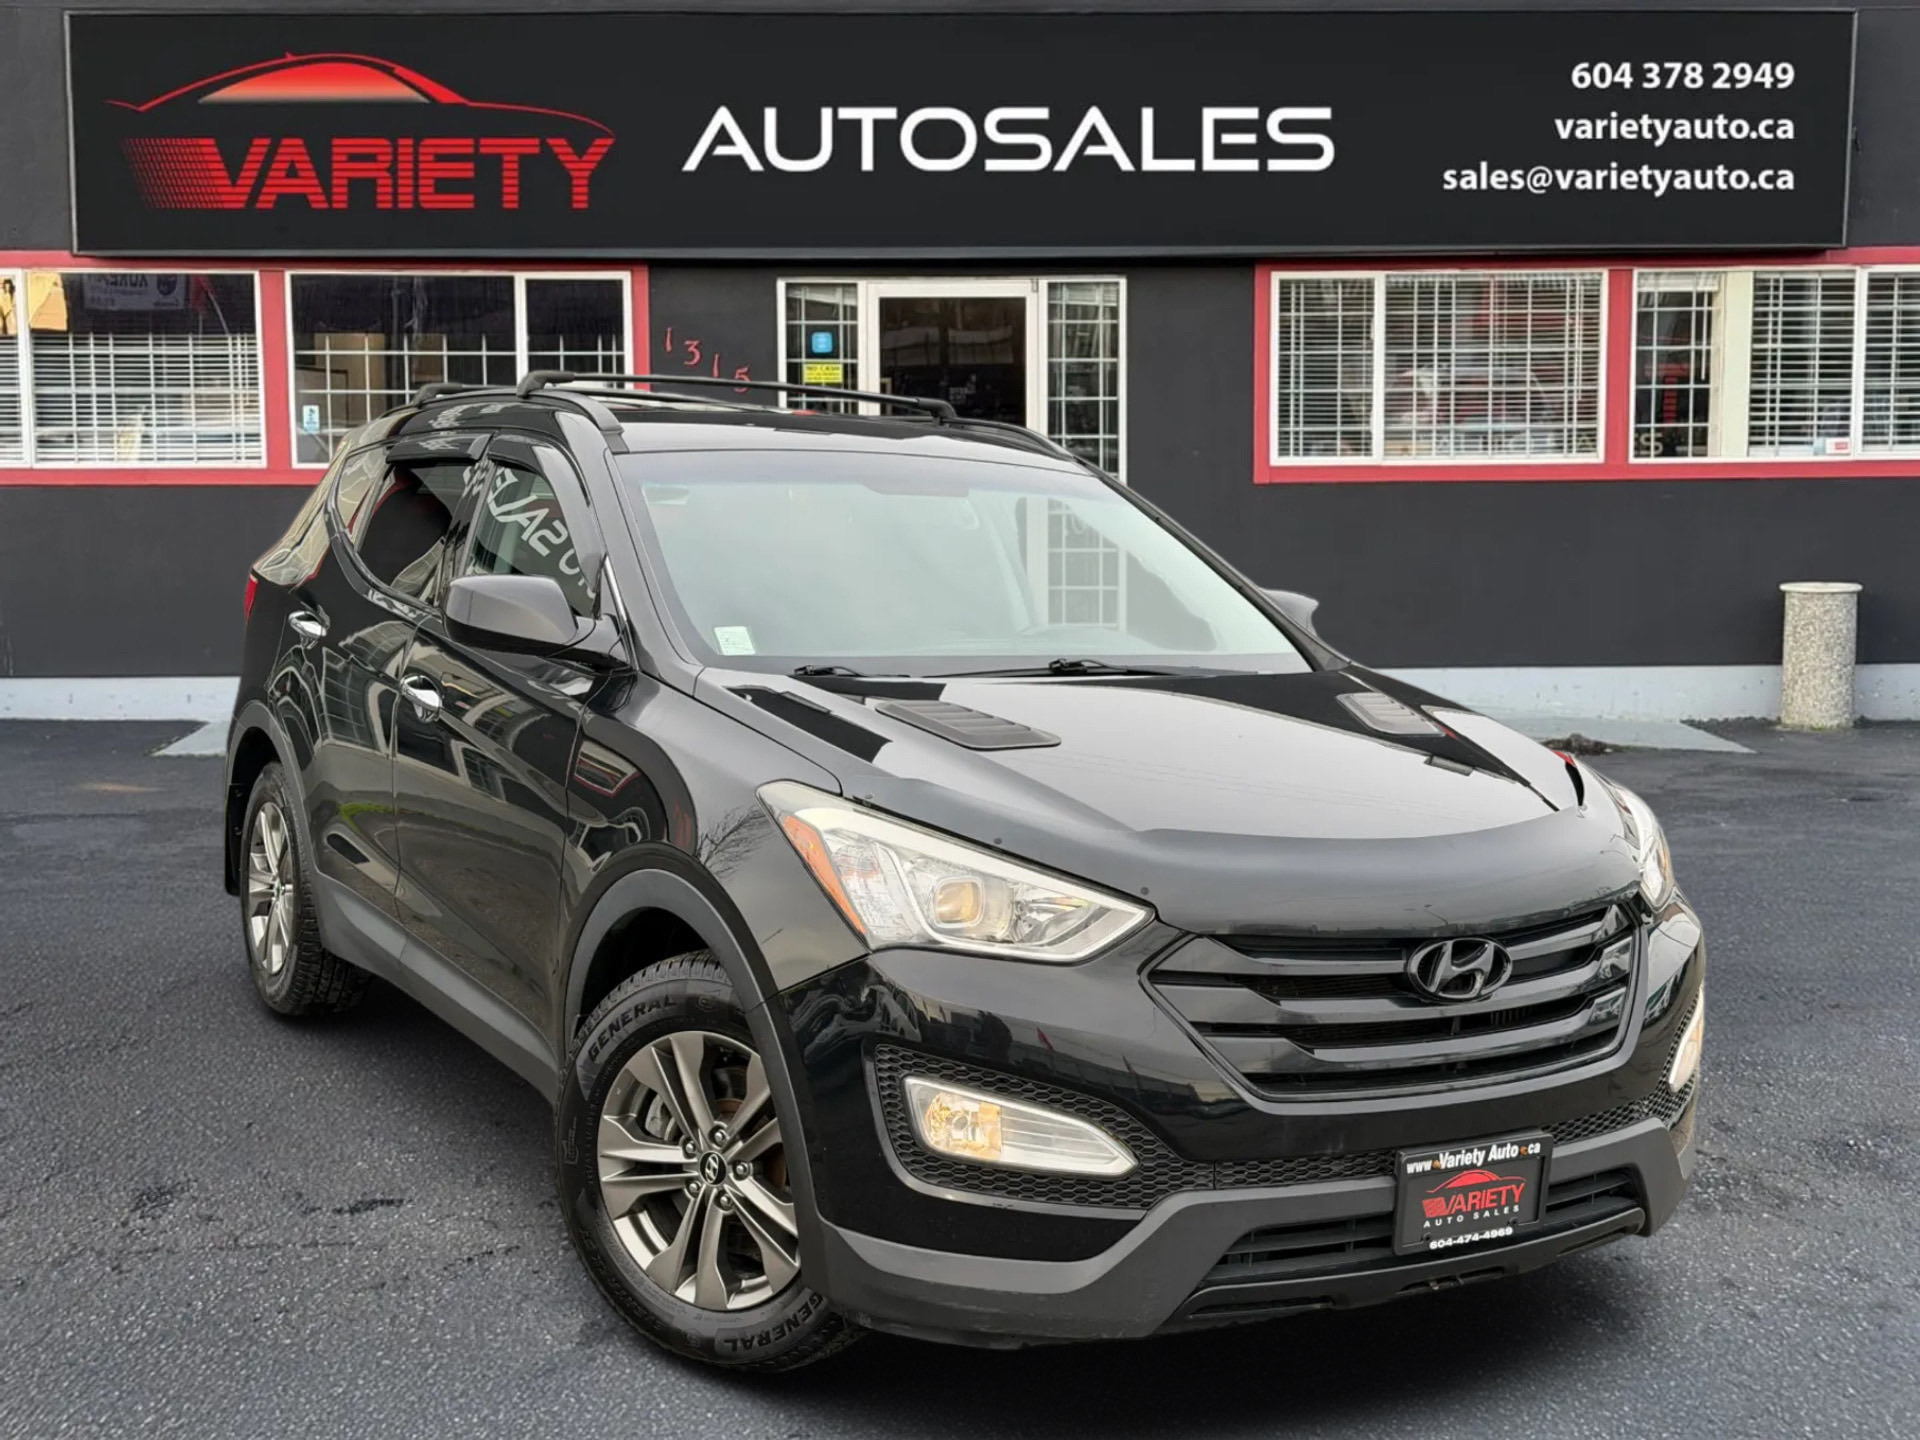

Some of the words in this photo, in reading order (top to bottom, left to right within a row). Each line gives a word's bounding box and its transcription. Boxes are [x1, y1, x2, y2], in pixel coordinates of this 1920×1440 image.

[1571, 61, 1634, 89] 604
[1642, 61, 1704, 89] 378
[1711, 61, 1795, 89] 2949
[682, 105, 1335, 172] AUTOSALES
[1554, 111, 1795, 147] varietyauto.ca
[125, 136, 615, 210] VARIETY
[1442, 160, 1795, 197] sales@varietyauto.ca
[588, 994, 678, 1062] GENERAL
[1422, 1183, 1526, 1218] VARIETY
[1423, 1215, 1464, 1229] AUTO
[1473, 1205, 1520, 1220] SALES
[723, 1292, 824, 1353] GENERAL
